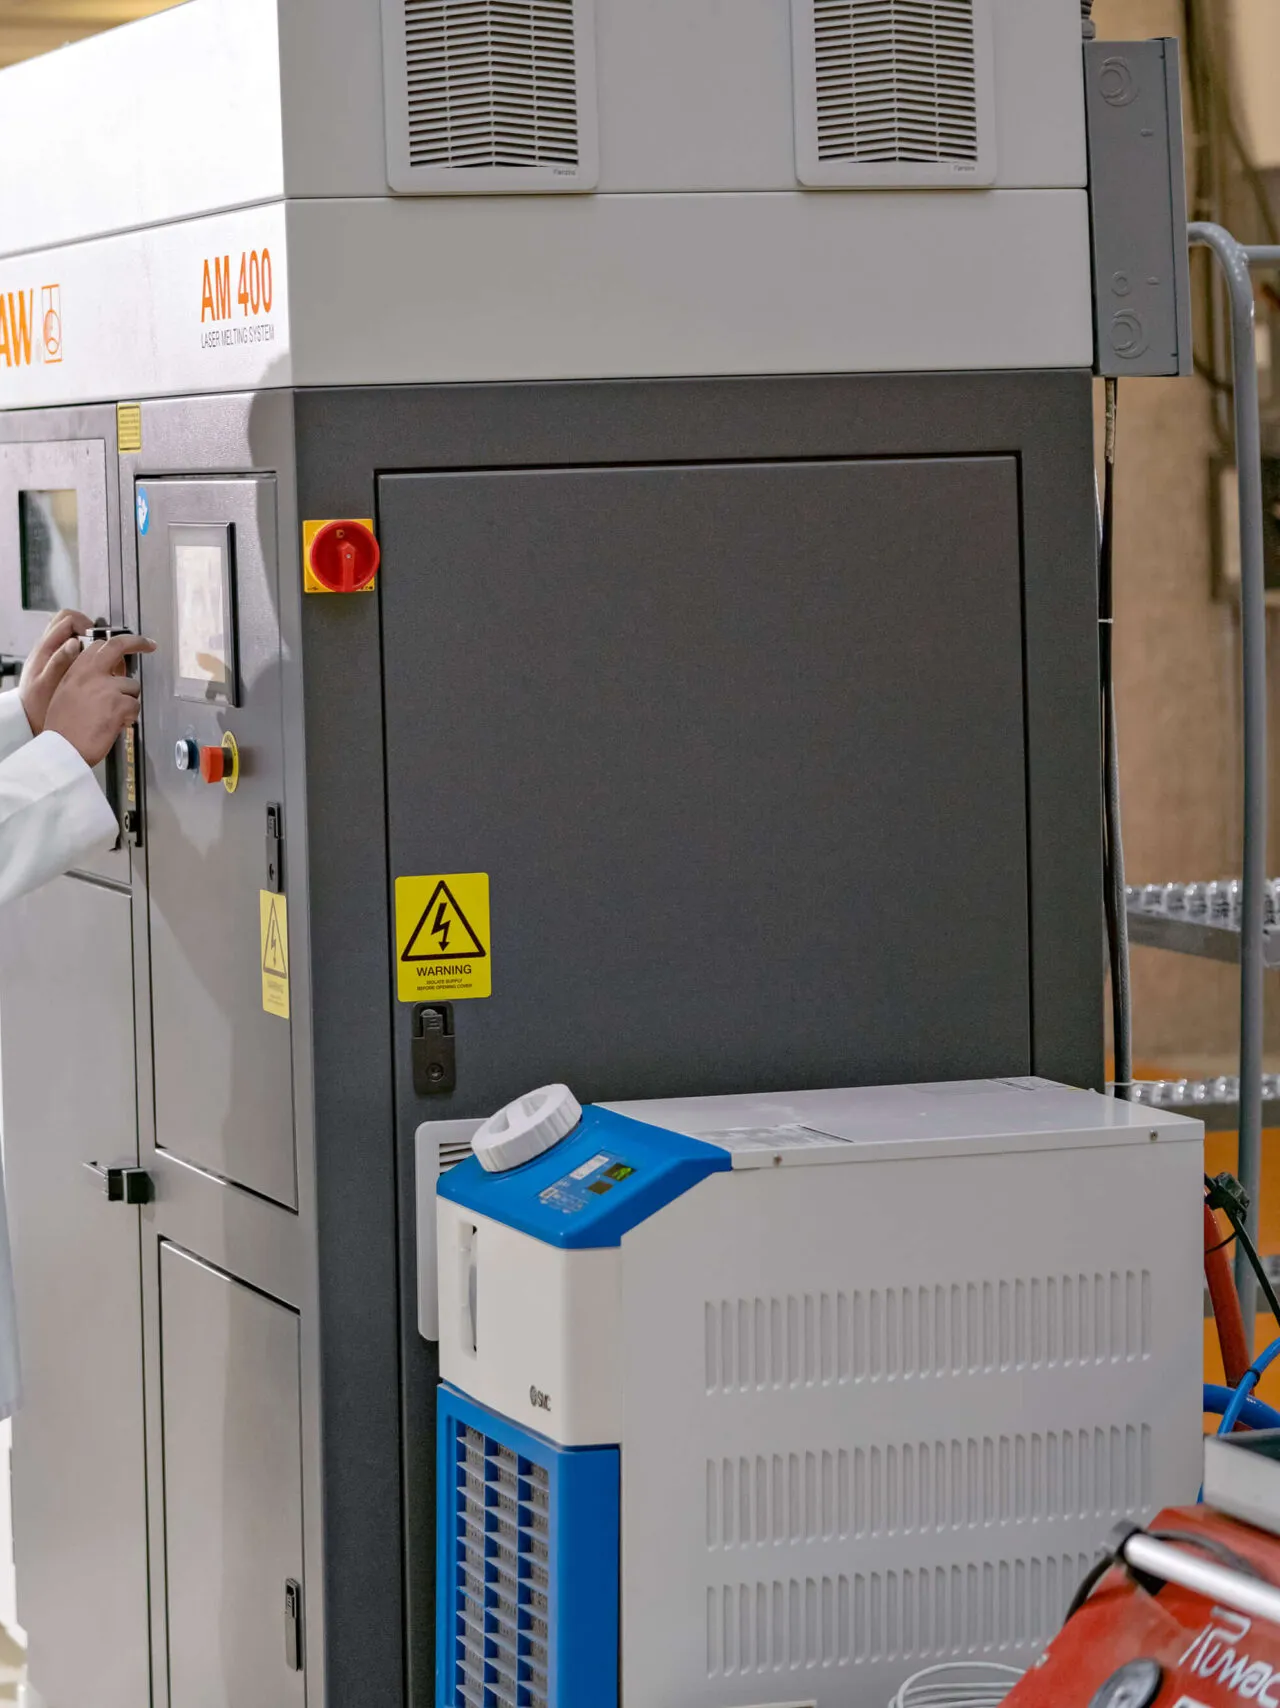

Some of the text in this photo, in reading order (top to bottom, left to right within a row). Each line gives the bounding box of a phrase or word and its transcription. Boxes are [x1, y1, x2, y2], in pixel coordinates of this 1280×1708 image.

[201, 247, 273, 323] AM 400
[201, 323, 275, 349] LASER MELTING SYSTEM
[416, 964, 472, 977] WARNING
